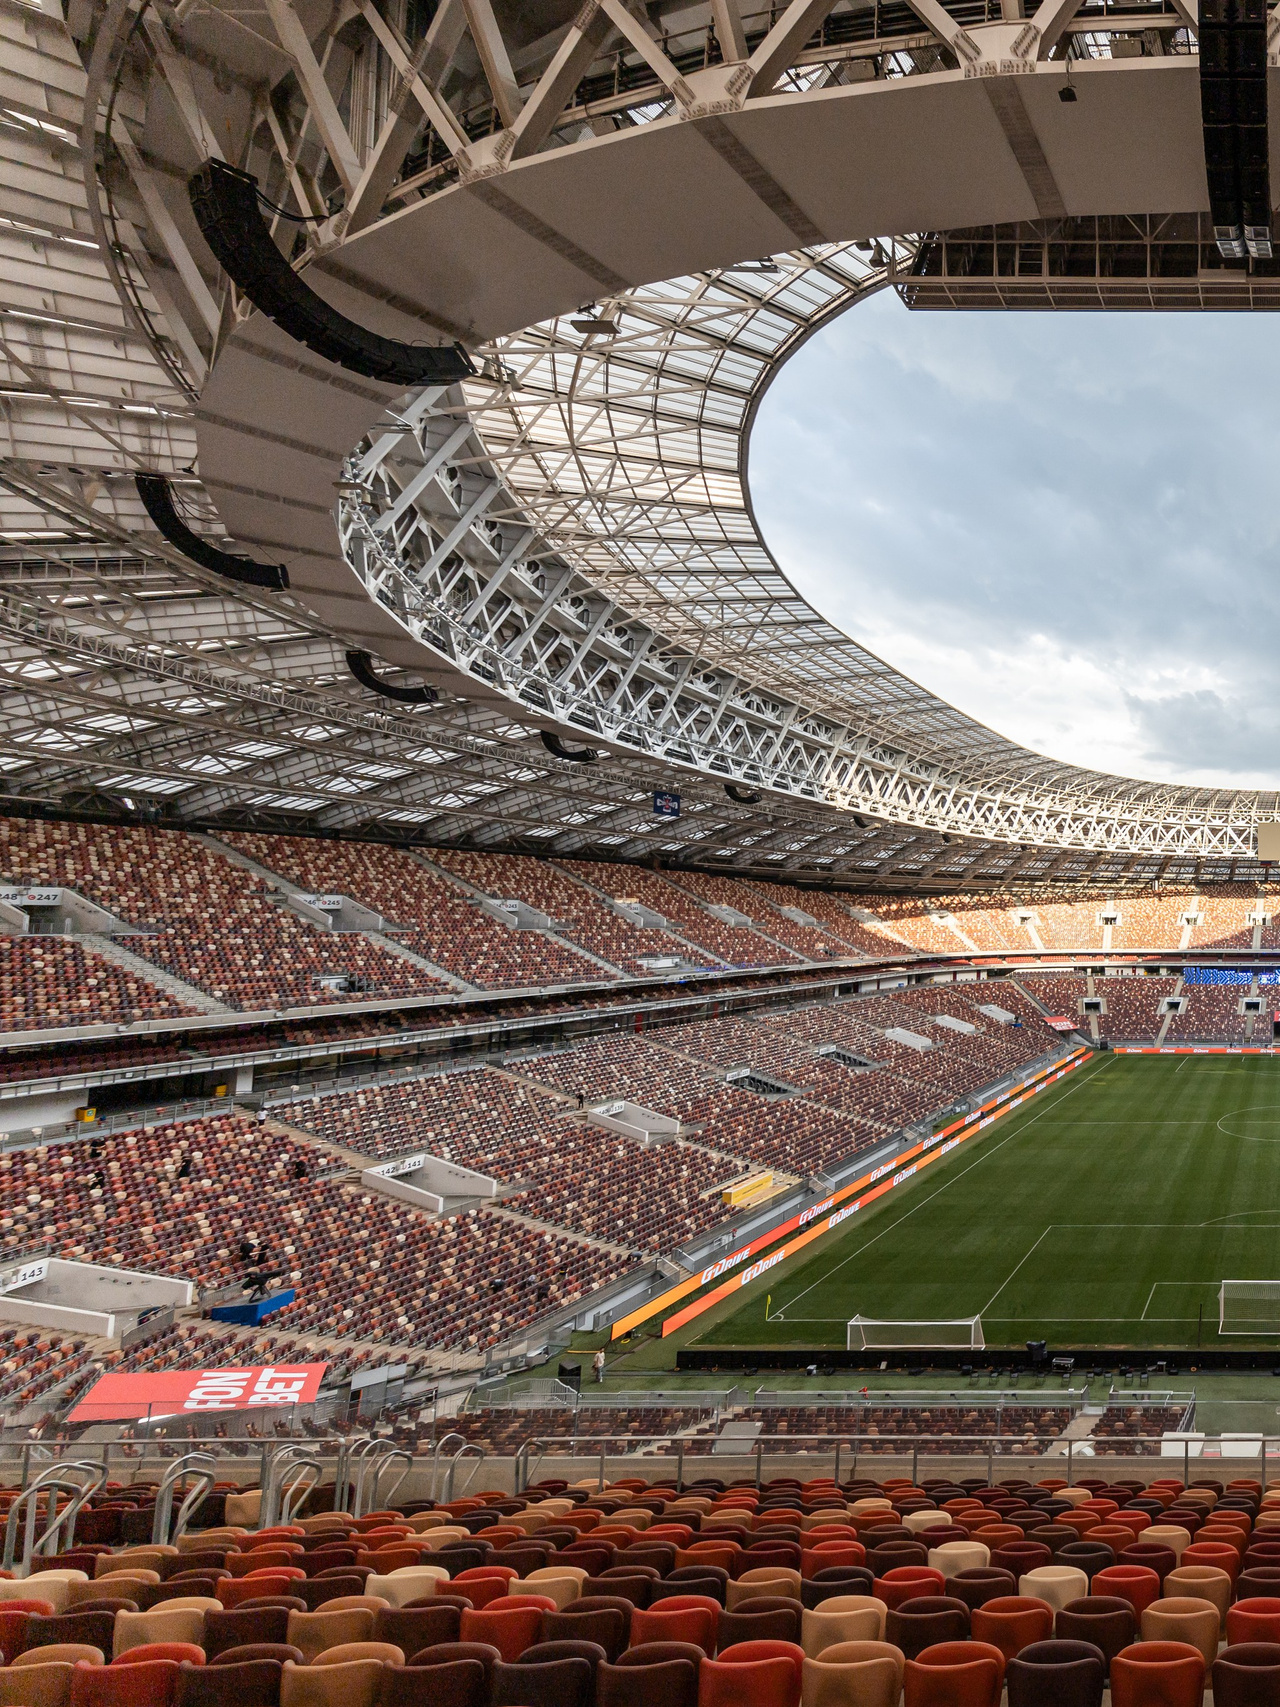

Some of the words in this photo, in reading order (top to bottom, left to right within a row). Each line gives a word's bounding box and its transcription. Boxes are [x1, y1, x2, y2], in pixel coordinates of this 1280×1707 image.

[381, 1167, 396, 1176] 142
[407, 1160, 421, 1169] 141
[21, 1266, 44, 1282] 143
[183, 1371, 253, 1409] FON
[247, 1367, 309, 1405] BET
